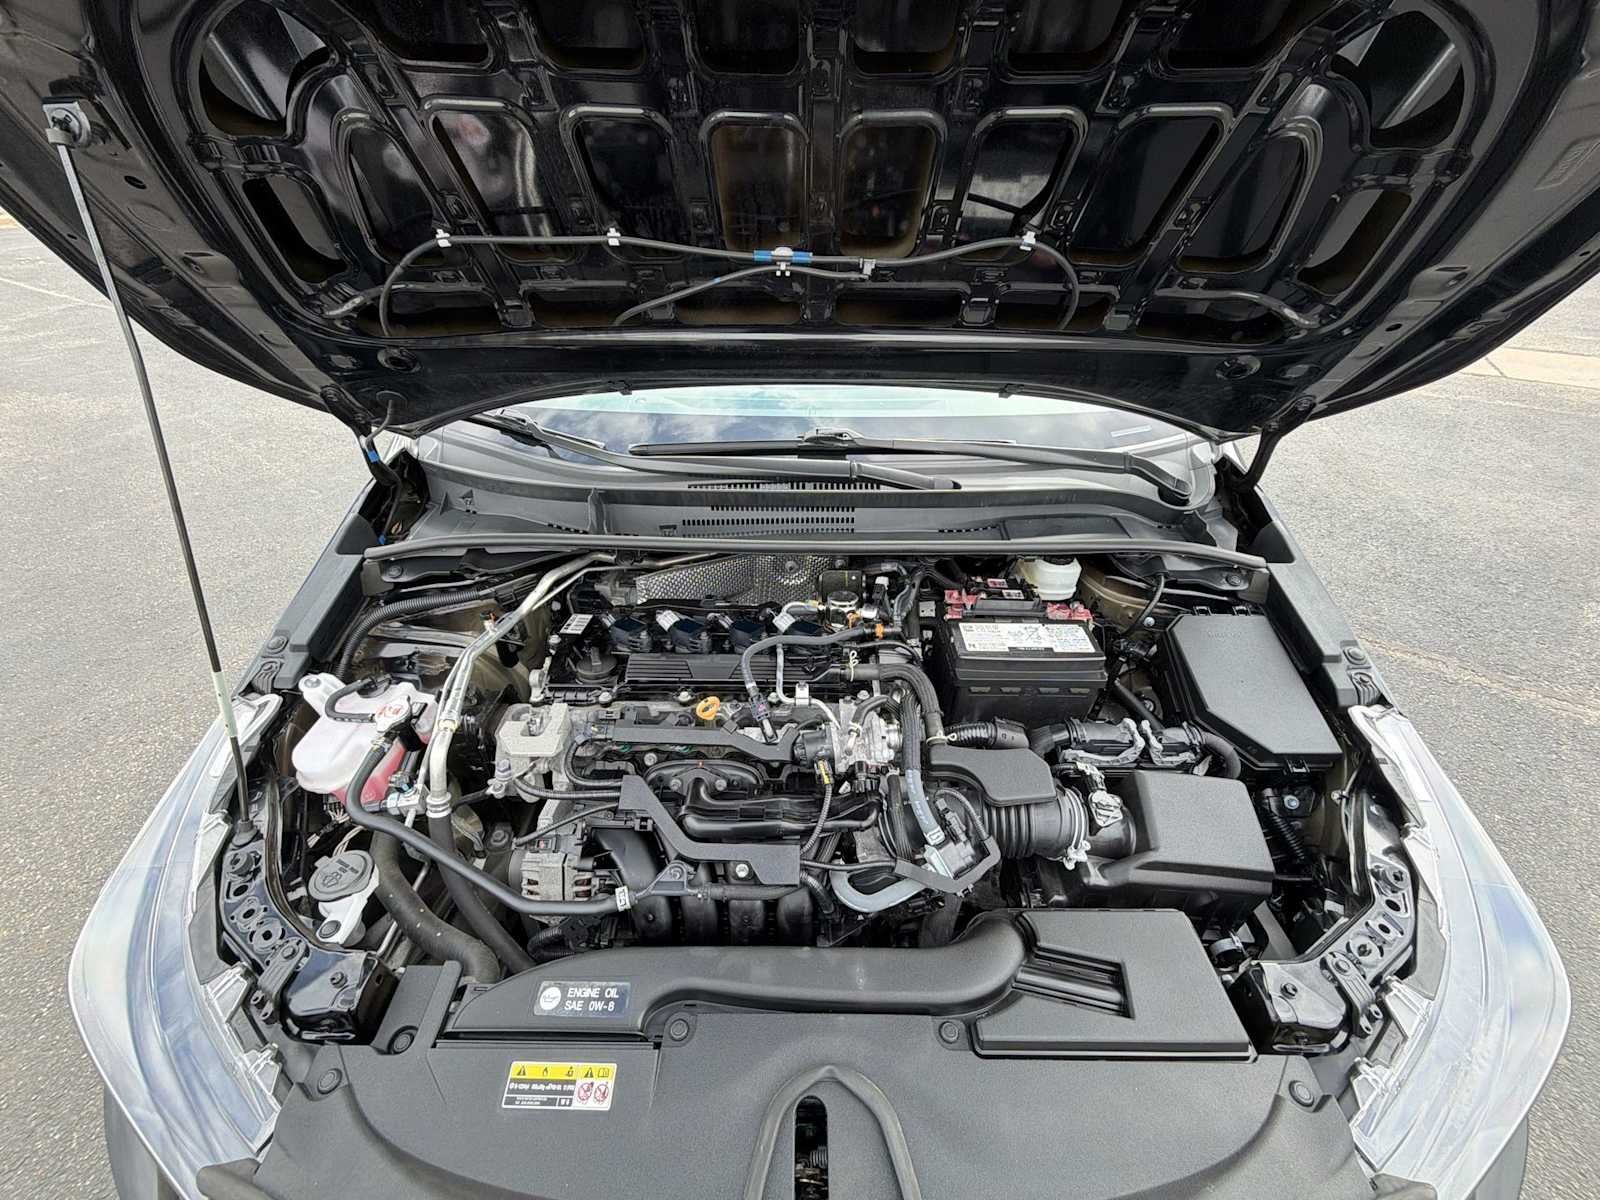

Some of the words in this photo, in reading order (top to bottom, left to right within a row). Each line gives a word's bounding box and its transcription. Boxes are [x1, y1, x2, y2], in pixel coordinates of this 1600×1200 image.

[567, 987, 601, 998] ENGINE
[604, 987, 620, 998] OIL
[564, 1000, 584, 1011] SAE
[588, 1000, 615, 1012] 0W-8
